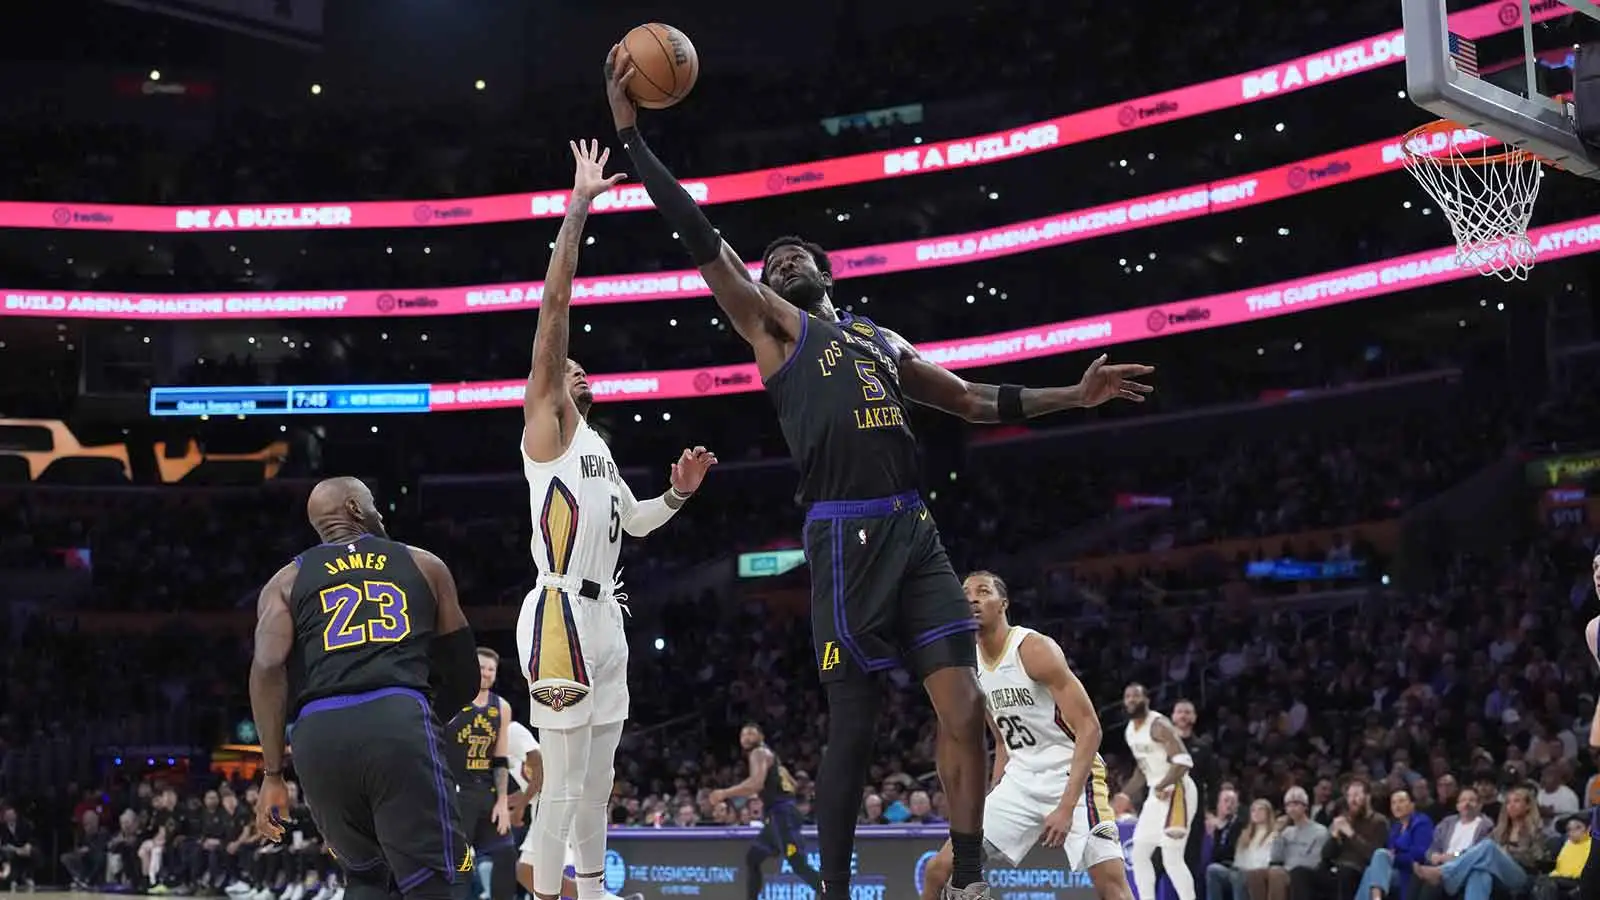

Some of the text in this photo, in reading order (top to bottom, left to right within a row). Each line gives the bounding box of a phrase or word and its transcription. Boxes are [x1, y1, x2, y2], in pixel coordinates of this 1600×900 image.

[1242, 72, 1280, 99] BE
[1281, 65, 1303, 88] A
[1138, 101, 1179, 119] twilio
[883, 125, 1059, 175] BE A BUILDER
[1308, 161, 1351, 181] twilio
[531, 195, 567, 216] BE
[175, 206, 353, 229] BE A BUILDER
[915, 240, 977, 262] BUILD
[397, 296, 439, 310] twilio
[465, 288, 520, 307] BUILD
[1245, 291, 1283, 312] THE
[1282, 271, 1380, 306] CUSTOMER
[4, 294, 347, 314] BUILD ARENA-SHAKING ENGAGEMENT
[1168, 307, 1211, 325] twilio
[818, 340, 843, 377] LOS
[854, 359, 887, 401] 5
[579, 454, 606, 479] NEW
[609, 494, 621, 544] 5
[323, 552, 388, 575] JAMES
[319, 580, 411, 651] 23
[991, 687, 1036, 710] ORLEANS
[996, 715, 1037, 750] 25
[467, 735, 491, 758] 77
[628, 865, 736, 882] THE COSMOPOLITAN
[987, 869, 1093, 888] COSMOPOLITA
